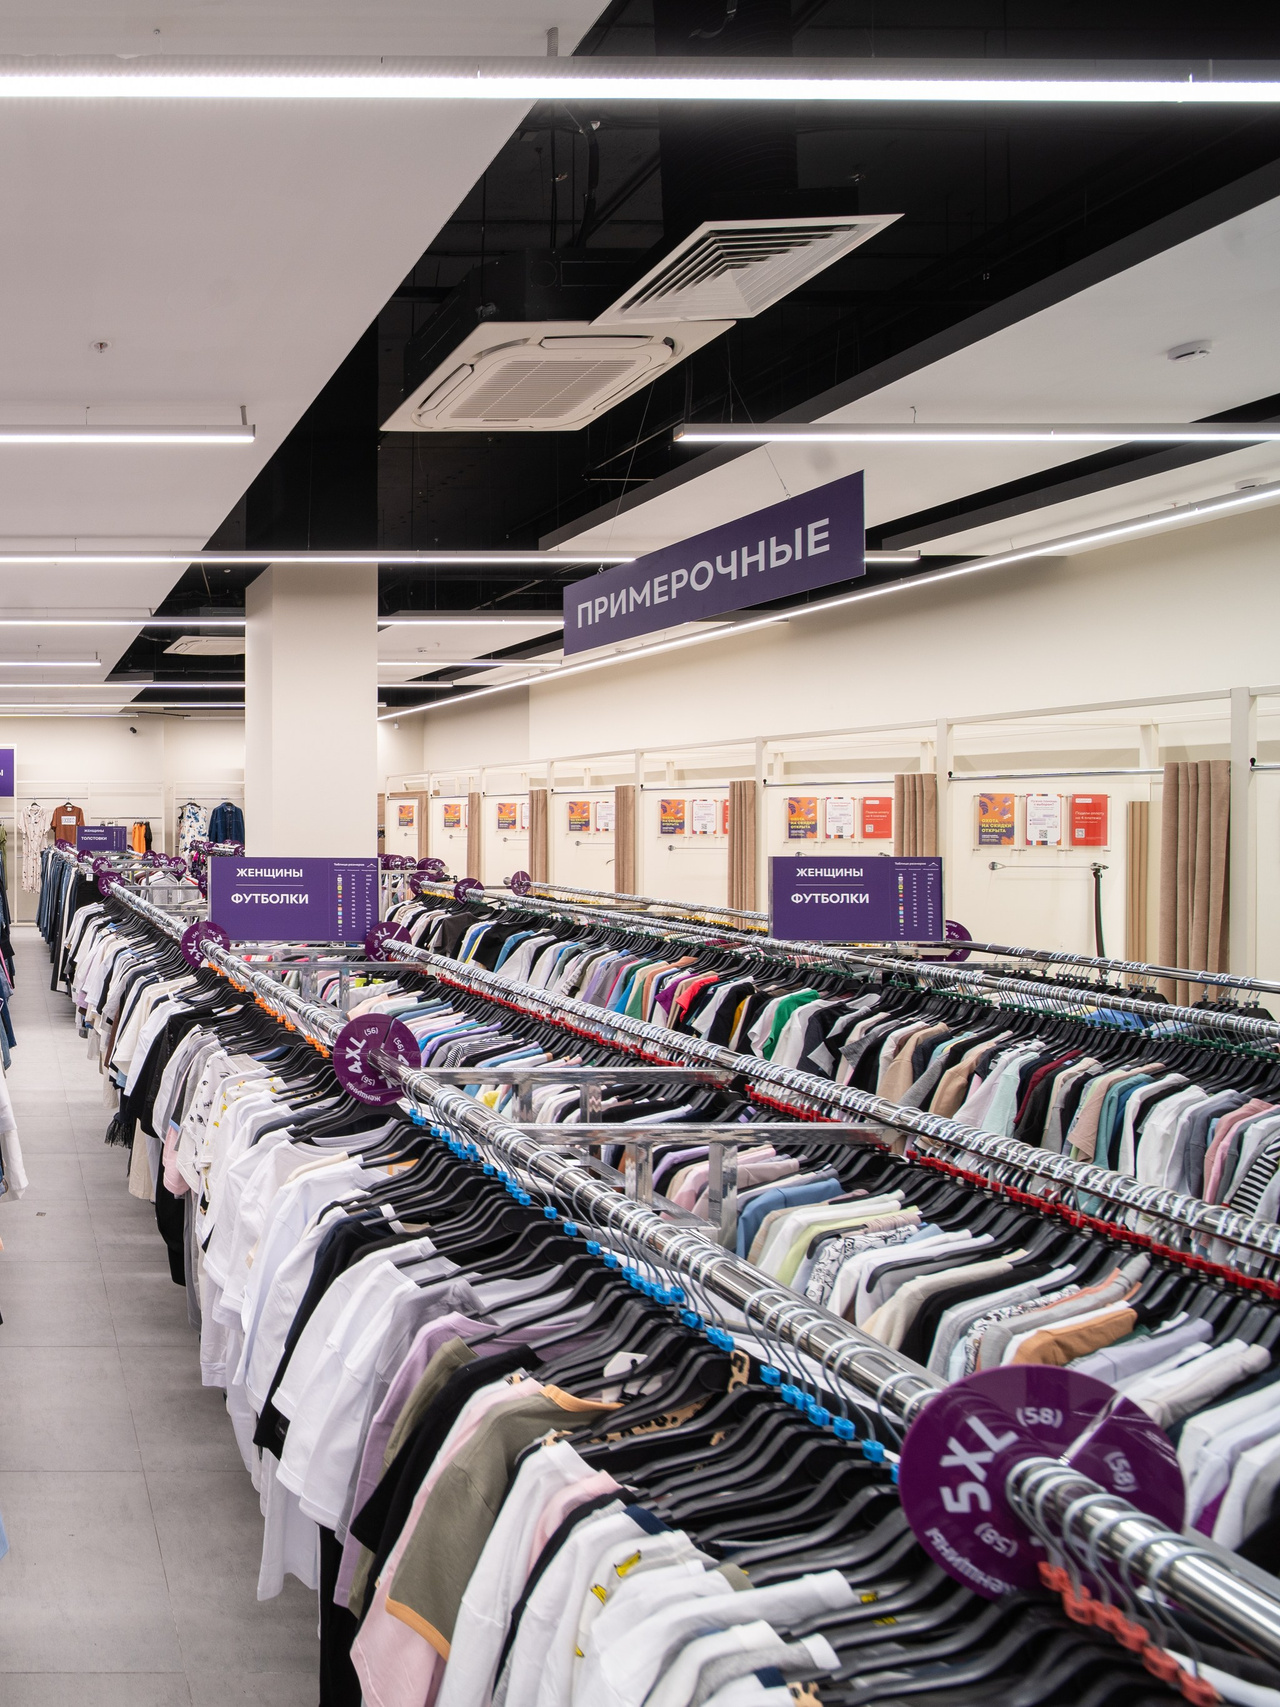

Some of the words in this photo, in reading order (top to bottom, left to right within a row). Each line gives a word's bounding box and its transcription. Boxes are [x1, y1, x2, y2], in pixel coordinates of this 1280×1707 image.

[577, 517, 830, 629] ПРИМЕРОЧНЫЕ
[236, 868, 303, 879] ЖЕНЩИНЫ
[796, 868, 864, 878] ЖЕНЩИНЫ
[231, 893, 309, 904] ФУТБОЛКИ
[791, 893, 870, 904] ФУТБОЛКИ
[375, 928, 391, 940] XL
[187, 940, 203, 961] 3XL
[364, 1027, 379, 1036] (56)
[393, 1037, 405, 1052] (56)
[345, 1037, 367, 1074] 4XL
[361, 1075, 375, 1086] (56)
[1016, 1407, 1063, 1428] (58)
[939, 1415, 1019, 1513] 5XL
[1103, 1451, 1139, 1492] (58)
[974, 1522, 1018, 1559] (58)
